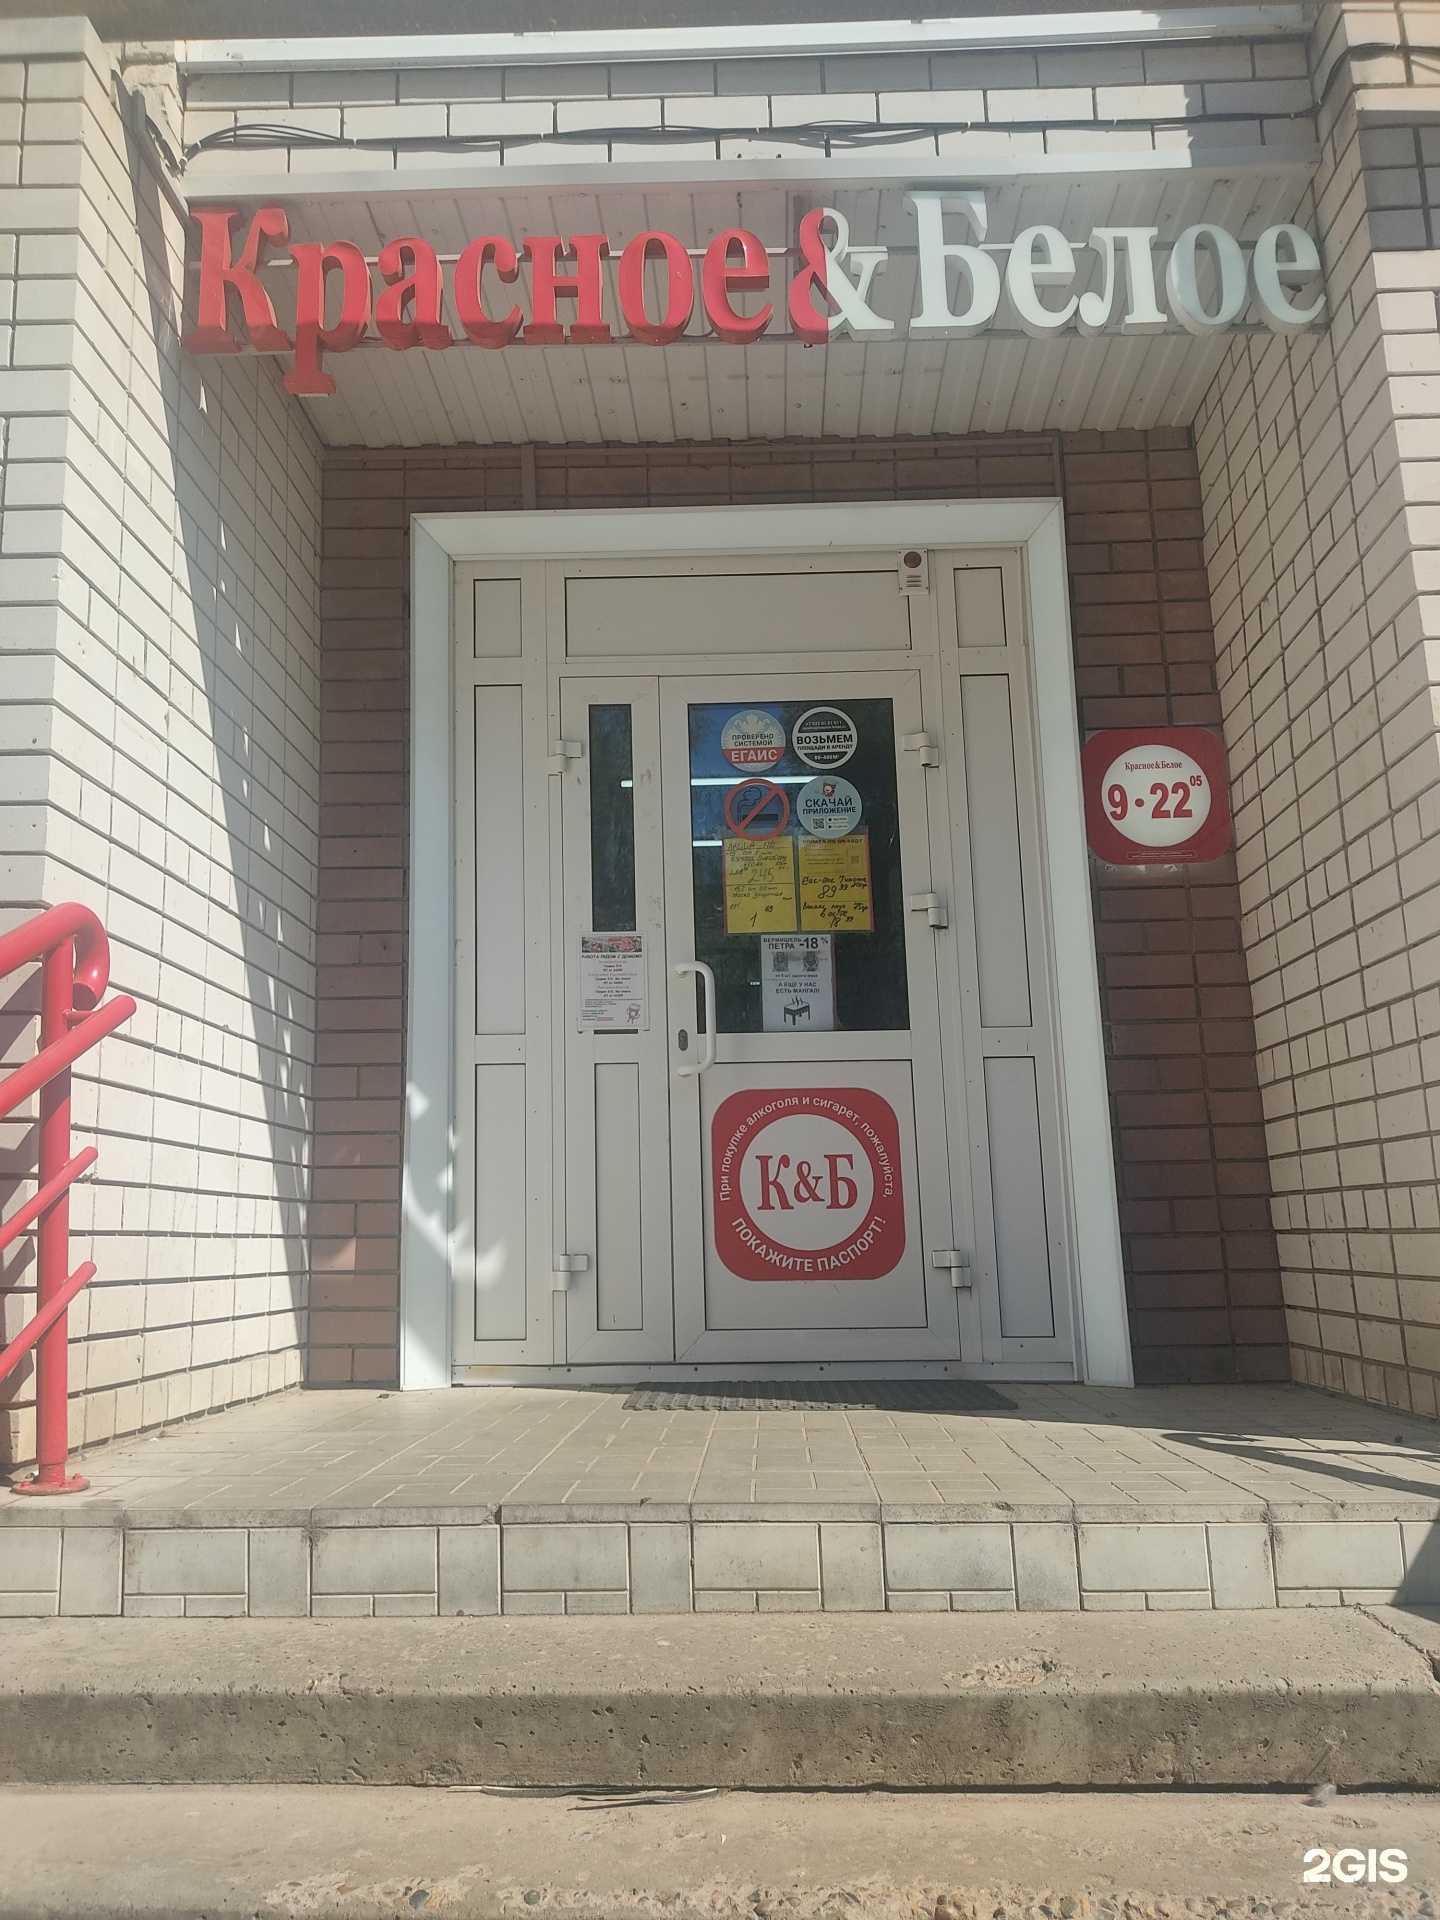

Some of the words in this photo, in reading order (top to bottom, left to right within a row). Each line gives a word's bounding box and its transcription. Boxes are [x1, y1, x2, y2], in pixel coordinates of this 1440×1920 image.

[189, 207, 774, 396] Красное
[909, 190, 1328, 340] Белое
[731, 733, 774, 741] ПРОВЕРЕНО
[733, 739, 774, 747] СИСТЕМОЙ
[796, 734, 853, 745] ВОЗЬМЕМ
[730, 749, 778, 763] ЕГАИС
[1189, 775, 1203, 787] 05
[805, 796, 853, 808] СКАЧАЙ
[802, 807, 857, 815] ПРИЛОЖЕНИЕ
[800, 937, 819, 949] -18
[802, 1096, 810, 1105] и
[746, 1096, 799, 1127] алкоголя
[812, 1097, 860, 1126] сигарет,
[722, 1123, 748, 1172] покупке
[719, 1174, 731, 1202] При
[731, 1217, 813, 1272] ПОКАЖИТЕ
[817, 1215, 886, 1272] ПАСПОРТ!
